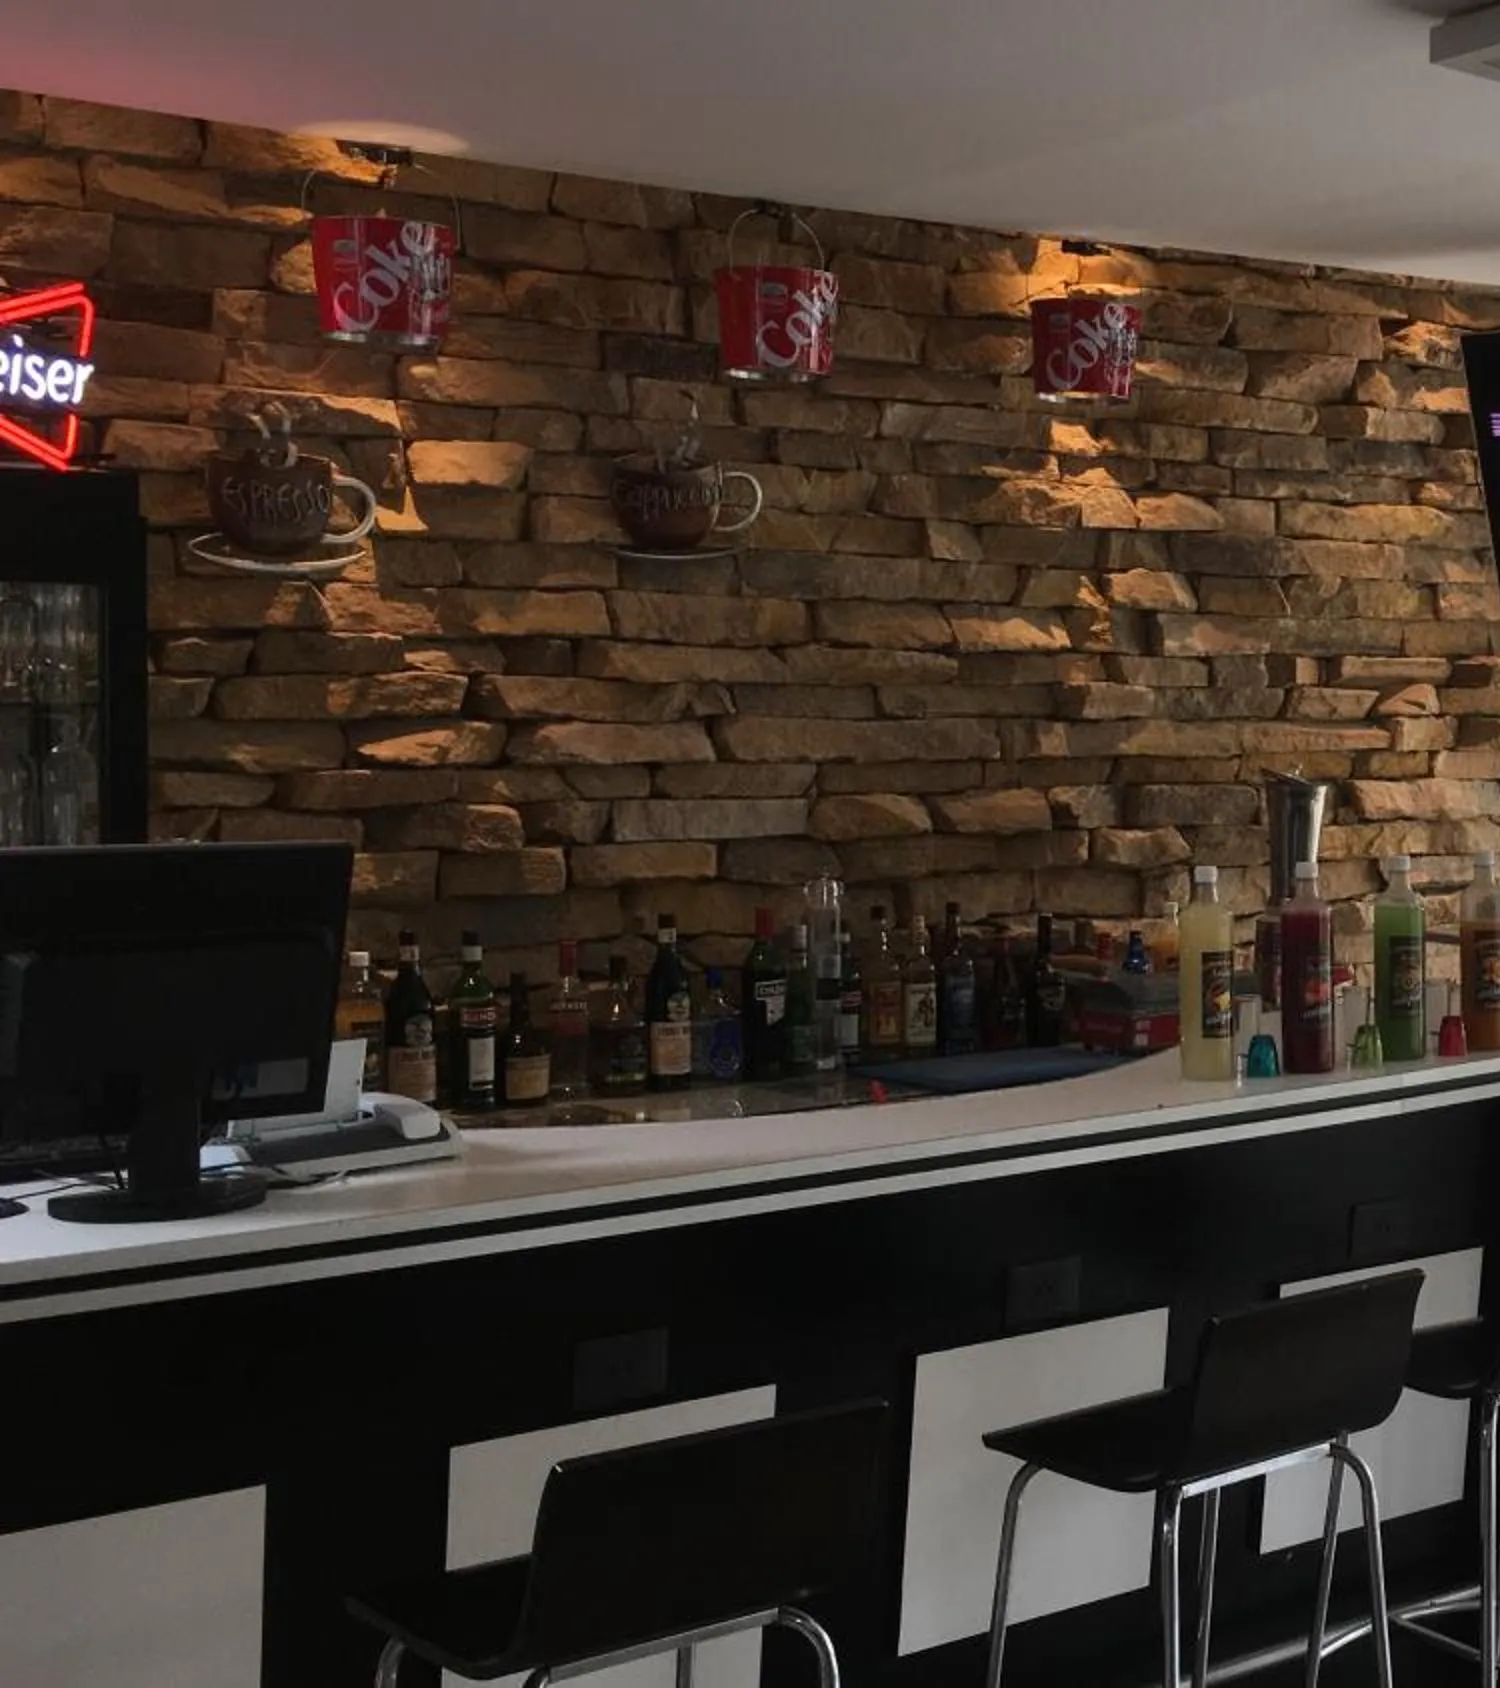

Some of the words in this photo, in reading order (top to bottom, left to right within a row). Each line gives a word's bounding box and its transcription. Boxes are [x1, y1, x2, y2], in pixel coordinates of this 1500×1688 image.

[333, 220, 424, 331] Coke
[756, 270, 839, 367] Coke
[1046, 303, 1127, 389] Coke
[221, 477, 331, 525] ESPRESSO
